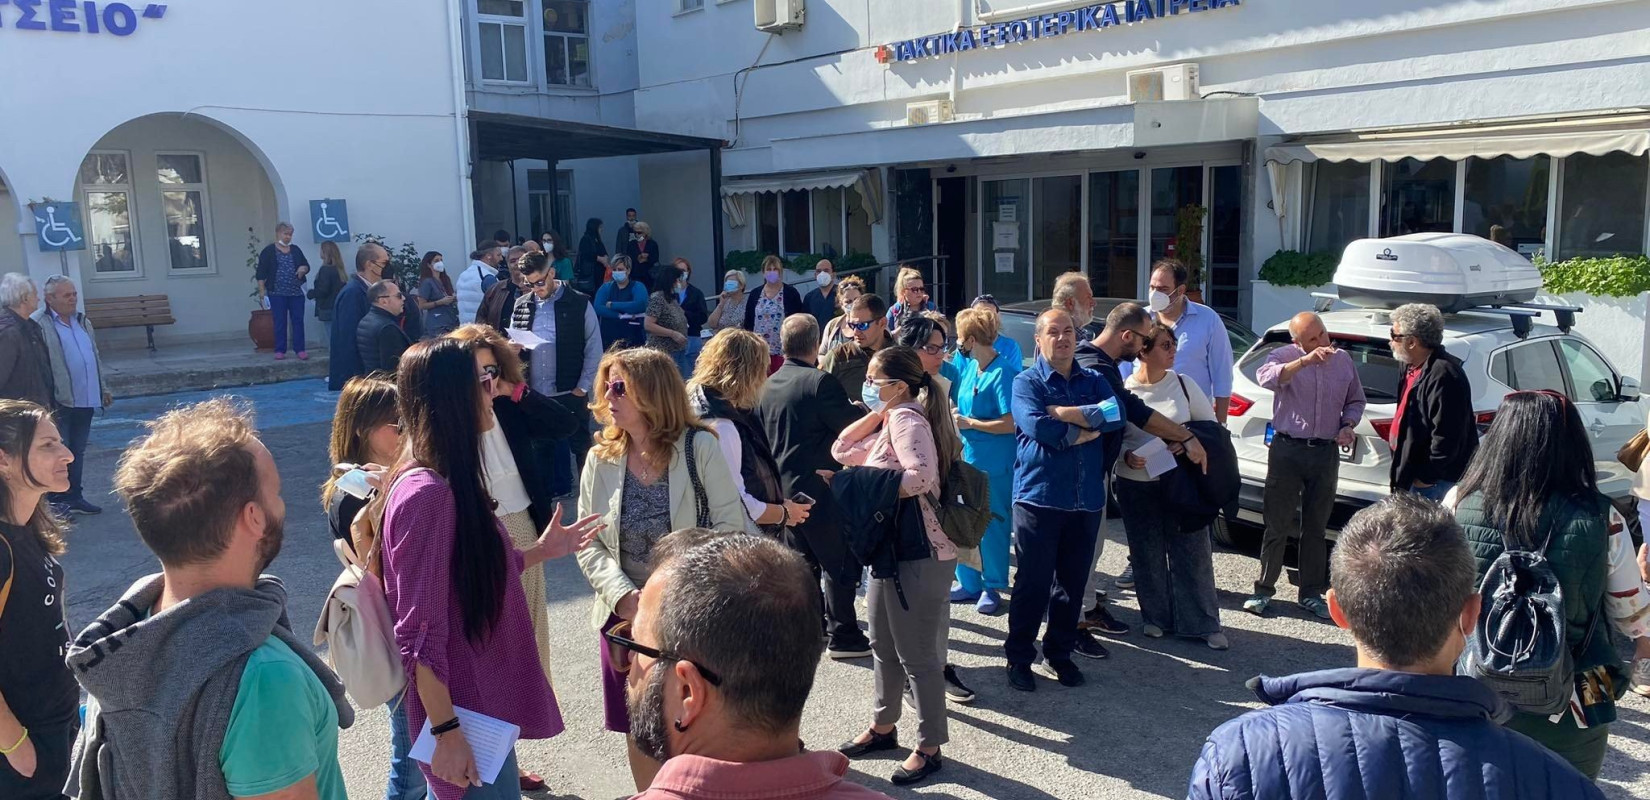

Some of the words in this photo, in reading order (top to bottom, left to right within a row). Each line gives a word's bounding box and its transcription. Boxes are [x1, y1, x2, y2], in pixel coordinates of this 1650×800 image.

[892, 29, 977, 62] ΤΑΚΤΙΚΑ
[980, 3, 1120, 48] ΕΞΩΤΕΡΙΚΑ
[1125, 0, 1240, 23] ΙΑΤΡΕ
